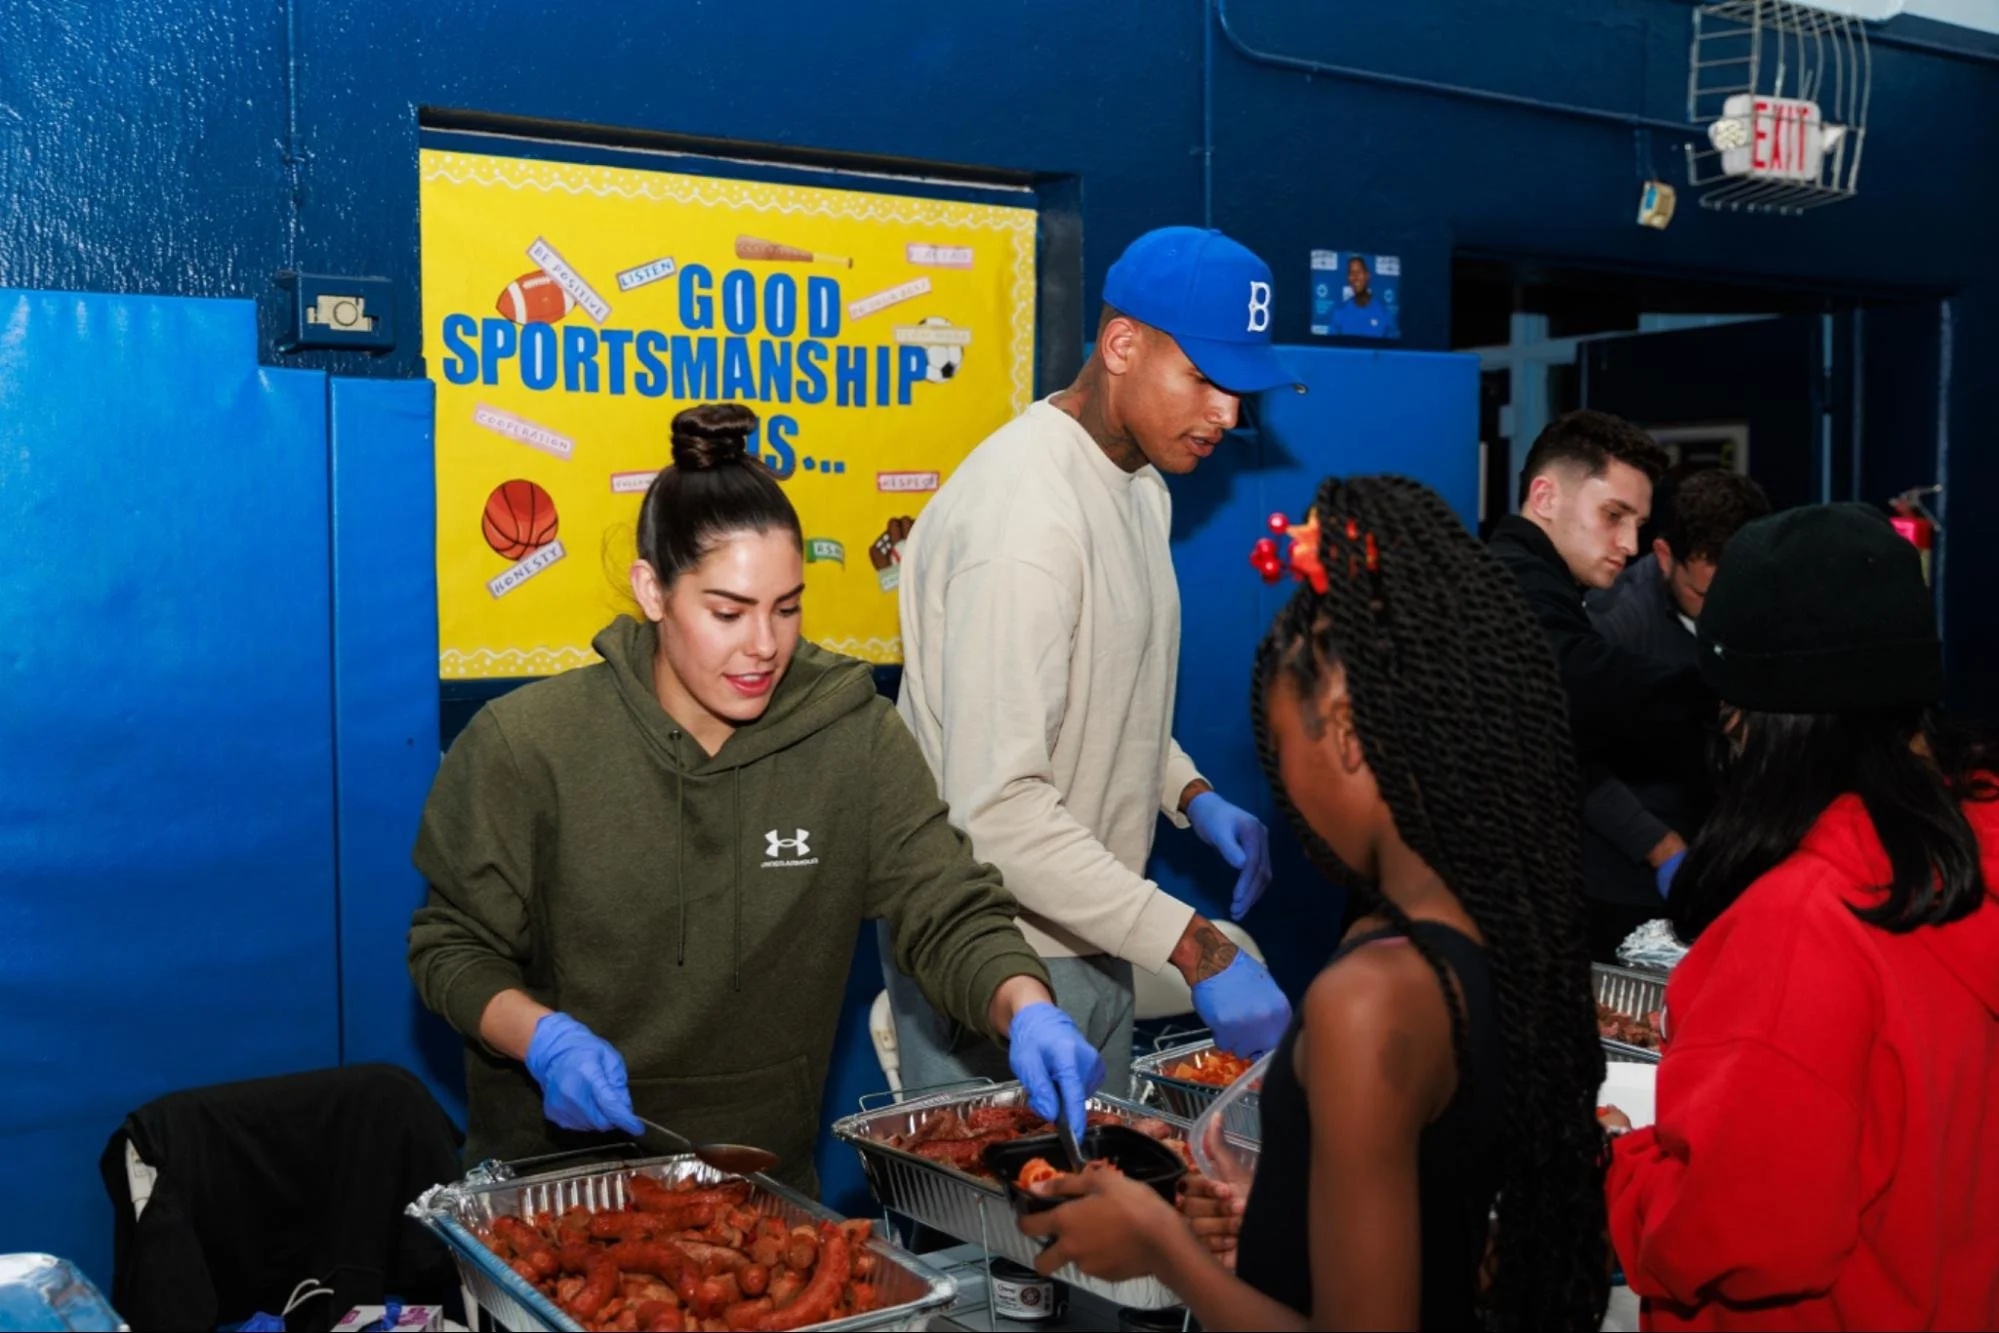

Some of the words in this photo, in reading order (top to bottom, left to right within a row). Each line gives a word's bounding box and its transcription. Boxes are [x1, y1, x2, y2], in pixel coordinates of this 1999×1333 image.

[1751, 102, 1809, 172] EXIT
[534, 246, 550, 262] BE
[552, 263, 604, 317] POSITIVE
[619, 260, 672, 288] LISTEN
[678, 264, 841, 338] GOOD
[1247, 281, 1271, 332] B
[442, 313, 929, 407] SPORTSMANSHIP
[478, 412, 568, 450] COOPERATION
[495, 546, 558, 593] HONESTY
